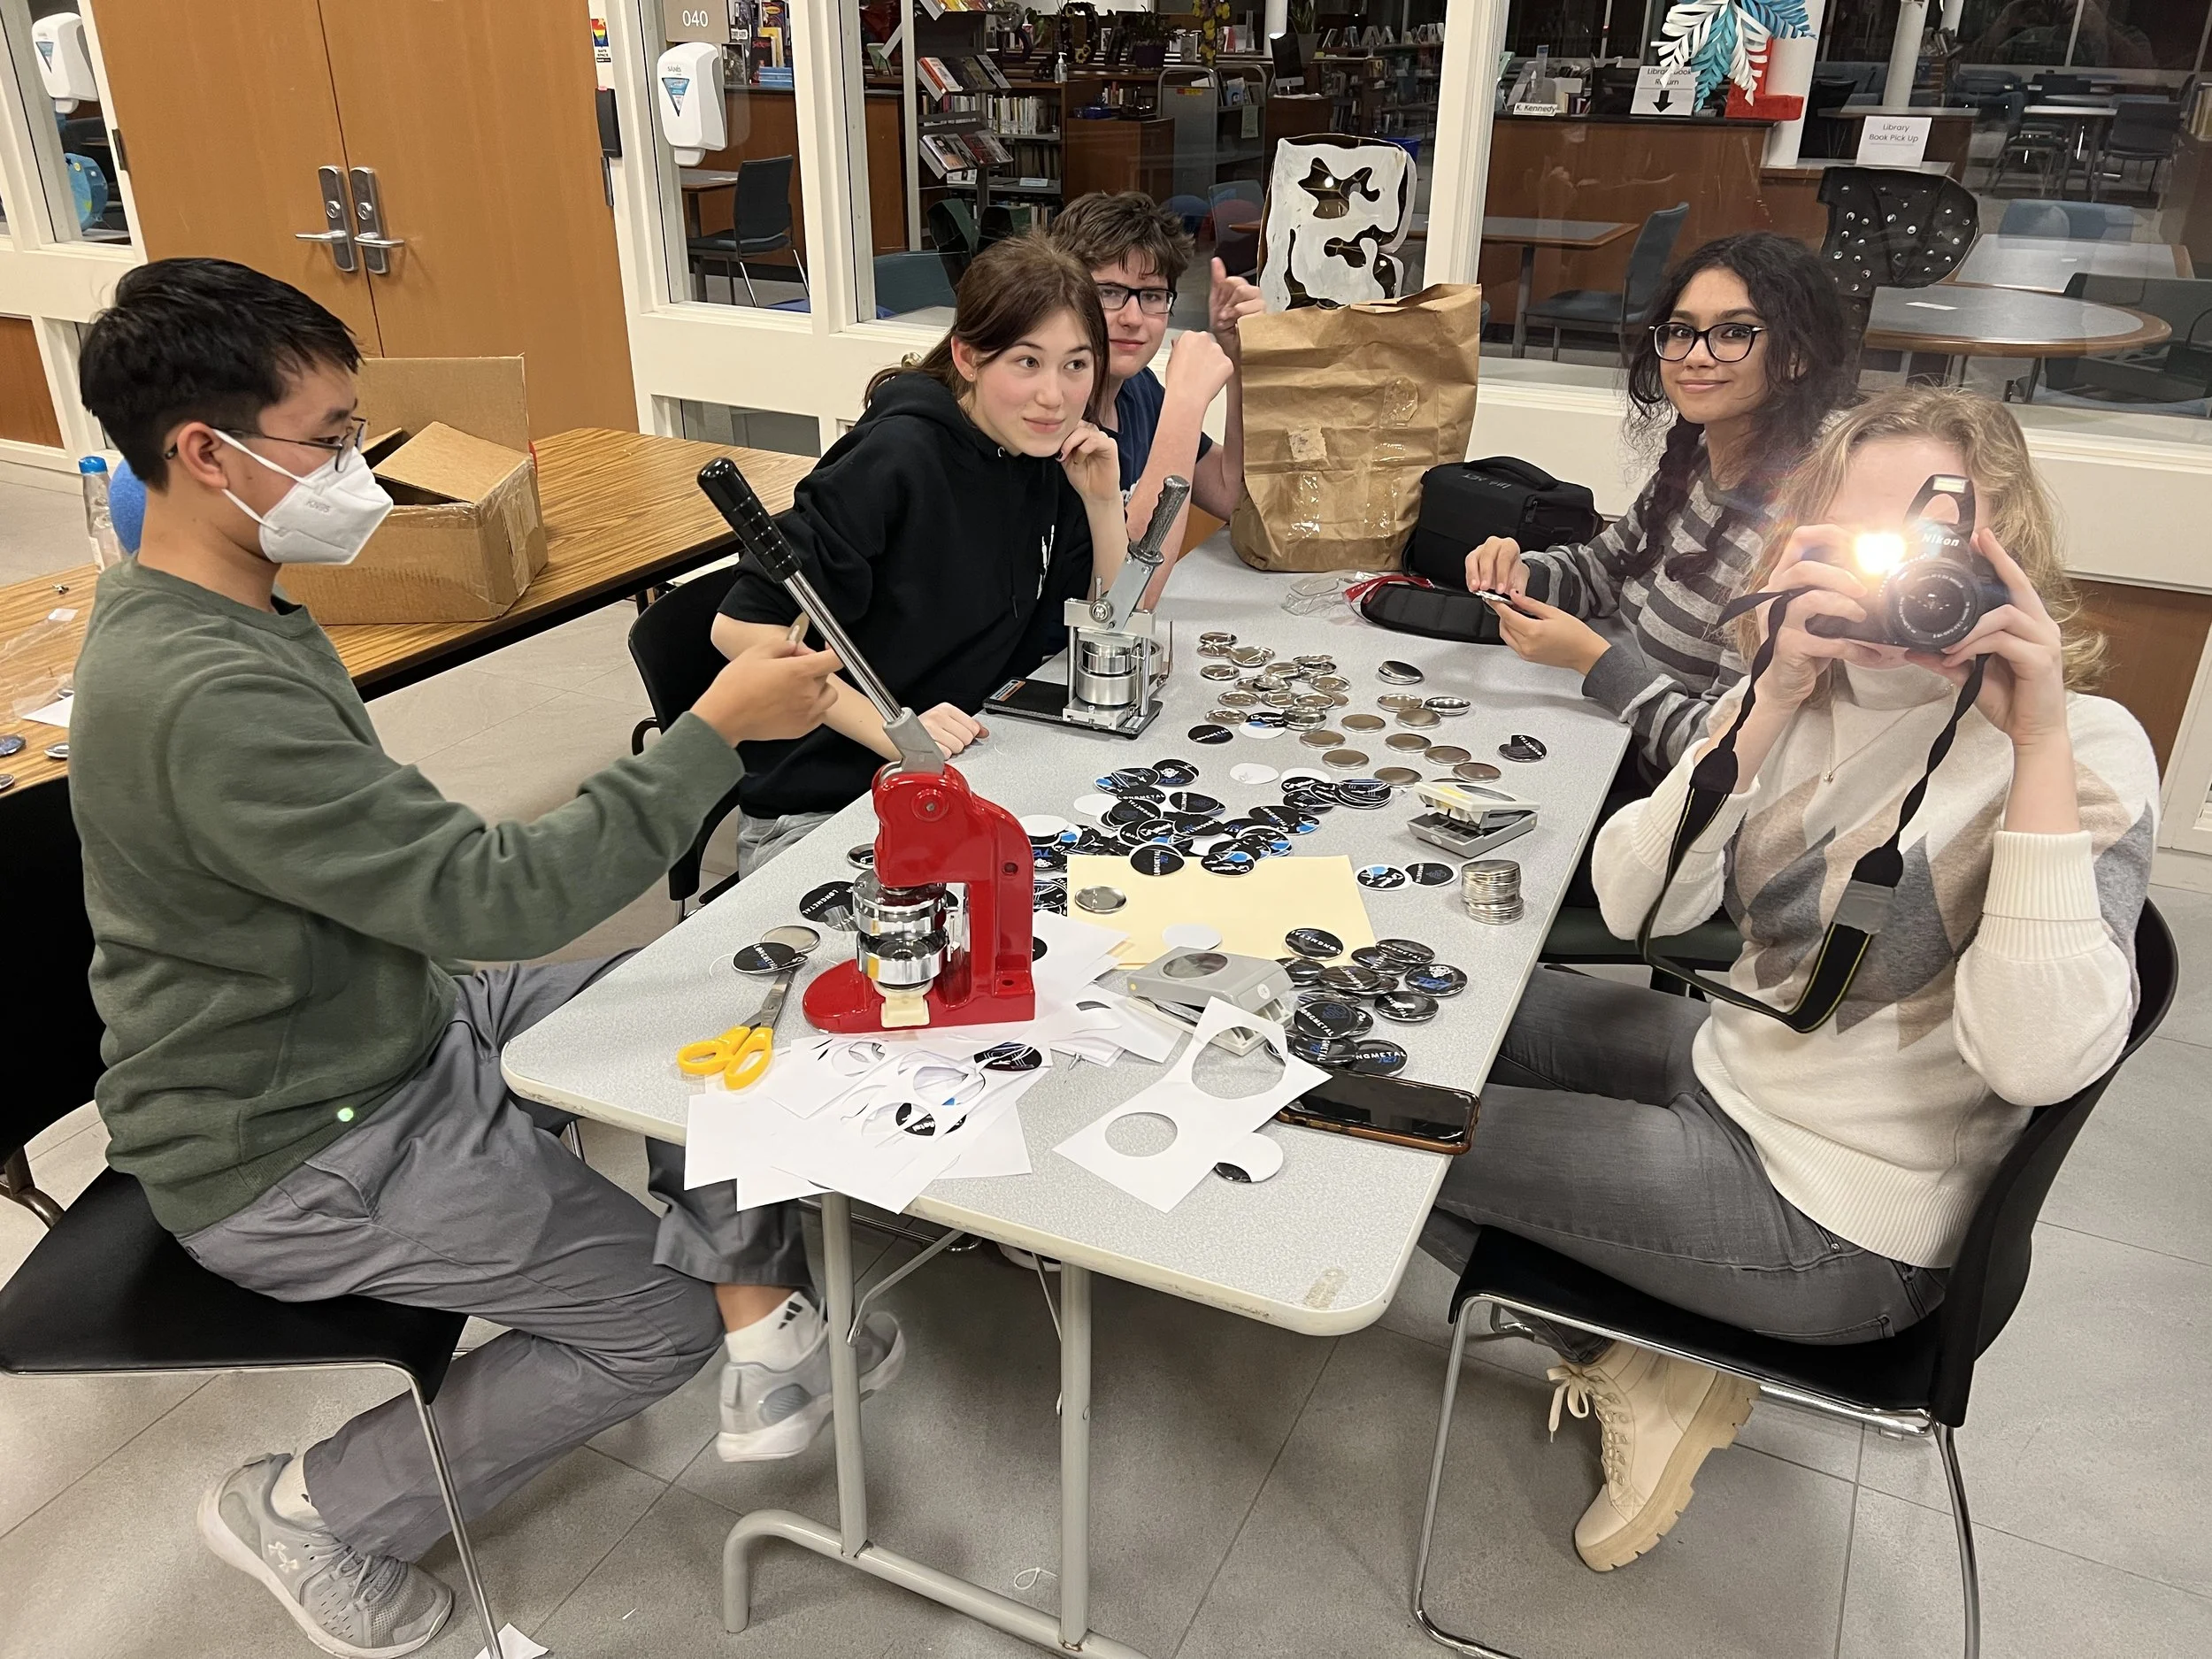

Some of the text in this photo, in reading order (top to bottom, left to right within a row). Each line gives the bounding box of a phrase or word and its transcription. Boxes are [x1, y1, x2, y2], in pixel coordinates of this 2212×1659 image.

[682, 10, 709, 27] 040
[1524, 104, 1557, 114] Kennedy
[1883, 124, 1910, 133] Library
[1921, 533, 1960, 547] Nikon
[802, 889, 839, 915] LONGMETAL
[1290, 930, 1342, 955] LONGMETAL
[1353, 1051, 1407, 1061] NGMETAL
